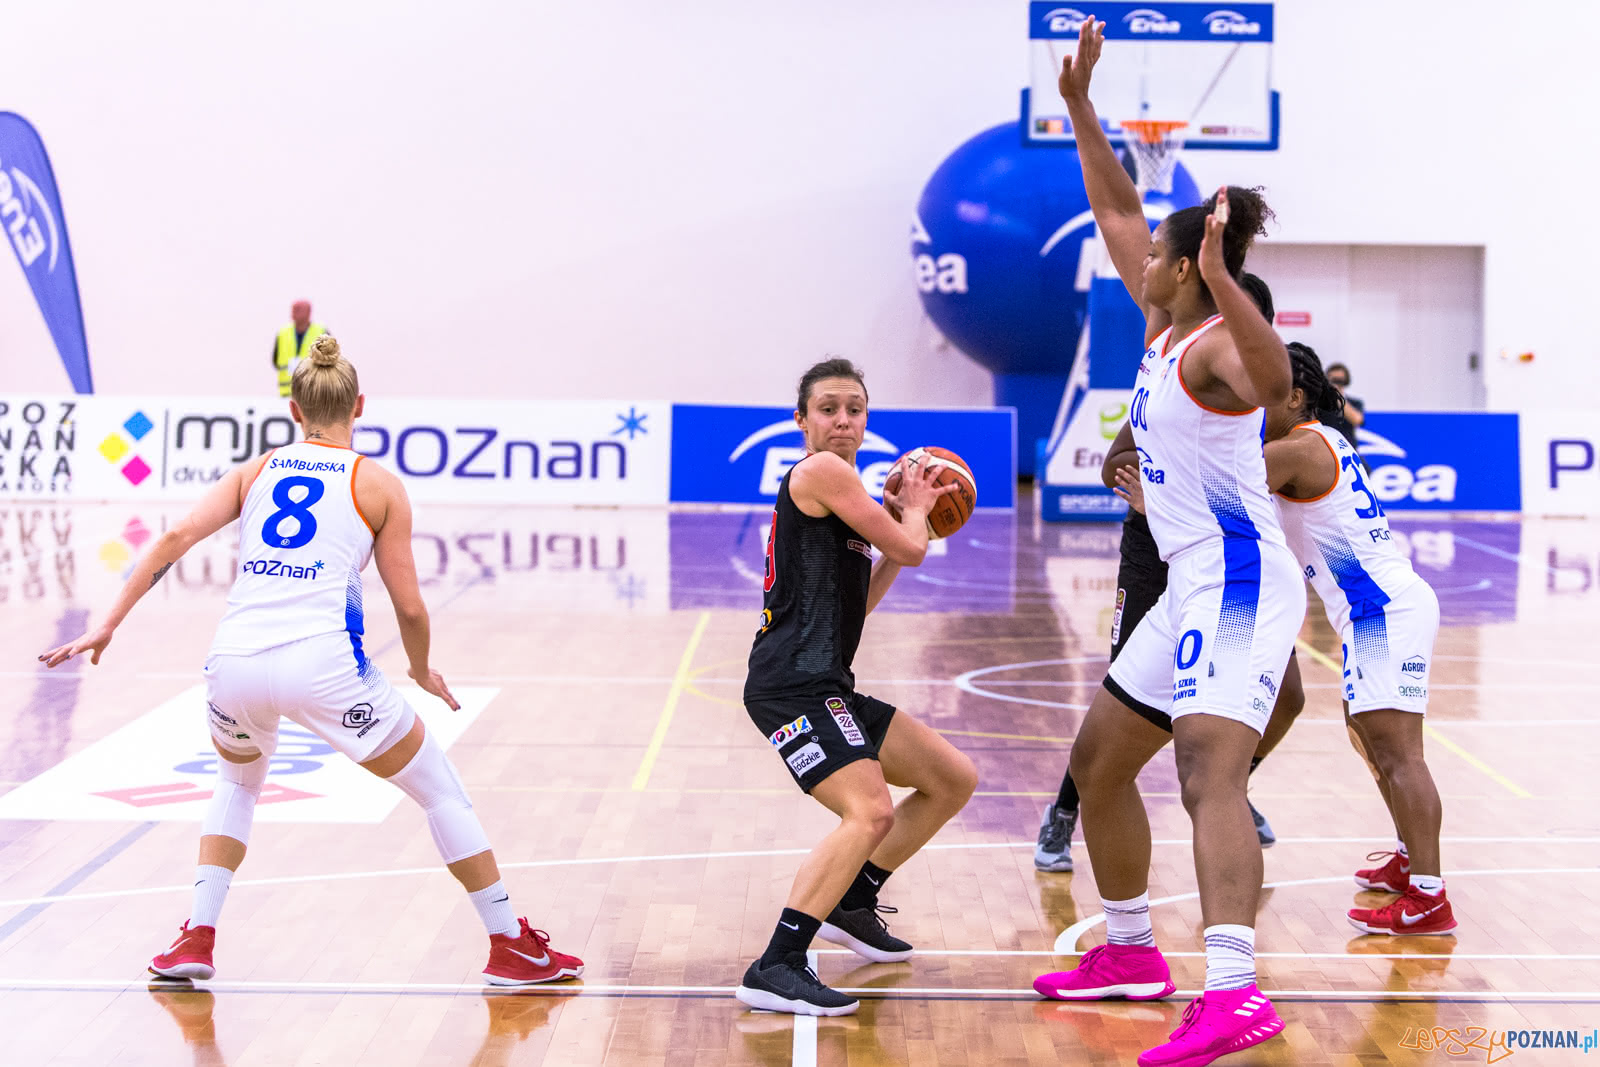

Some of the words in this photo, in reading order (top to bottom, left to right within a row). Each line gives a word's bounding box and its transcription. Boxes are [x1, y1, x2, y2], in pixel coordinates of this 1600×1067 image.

[1129, 19, 1181, 34] Enea
[1209, 19, 1261, 35] Enea
[269, 458, 346, 473] SAMBURSKA
[261, 475, 325, 549] 8
